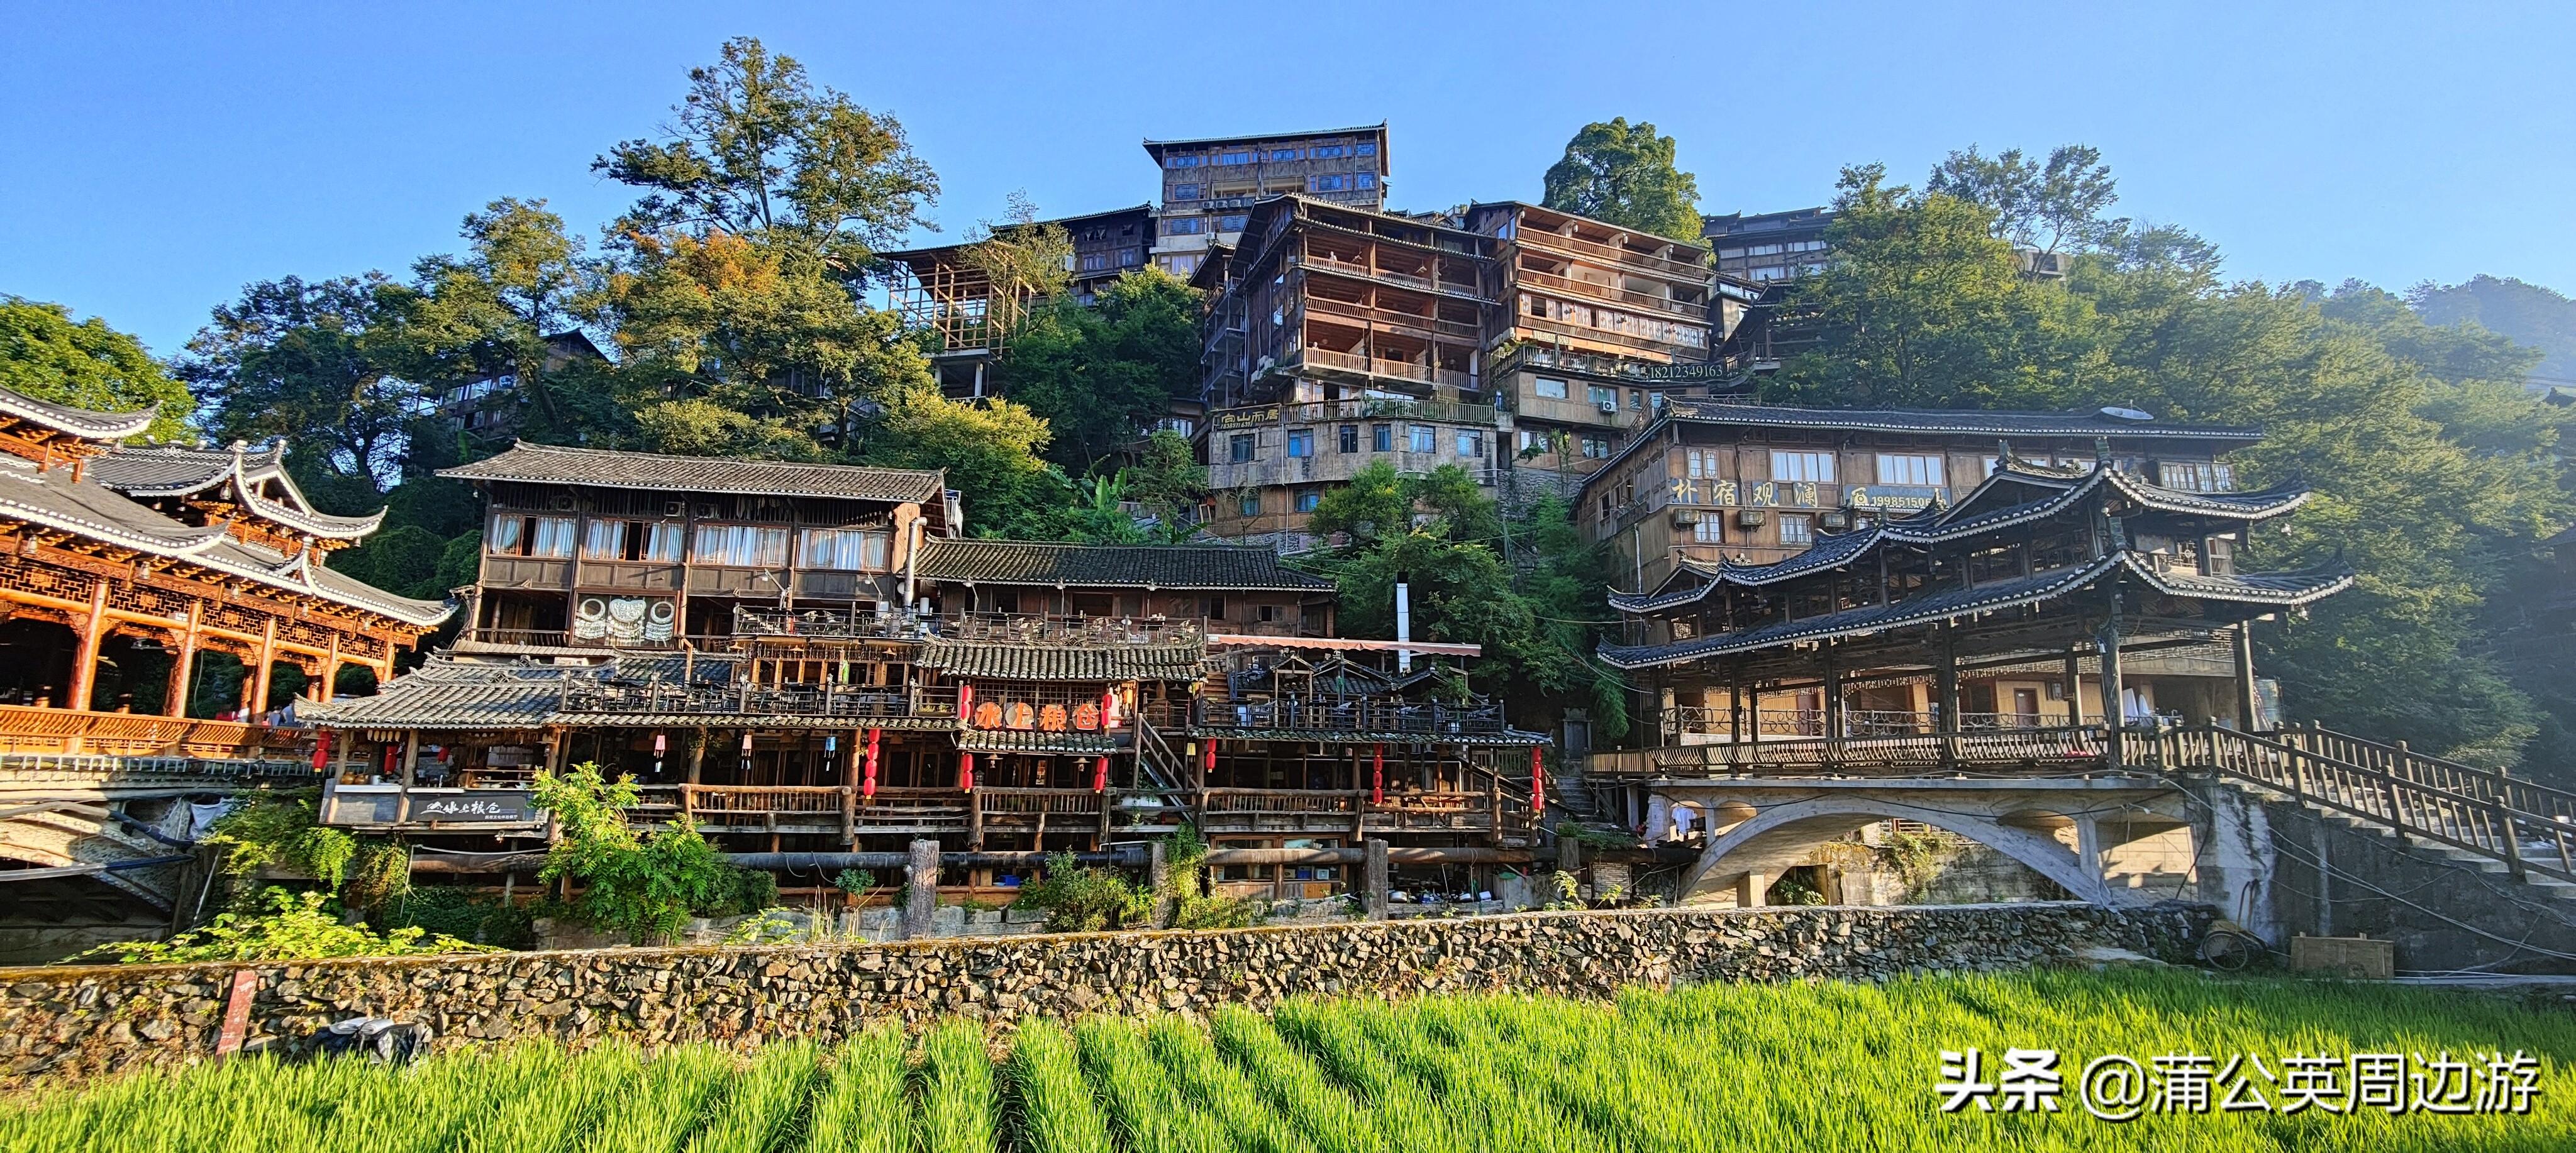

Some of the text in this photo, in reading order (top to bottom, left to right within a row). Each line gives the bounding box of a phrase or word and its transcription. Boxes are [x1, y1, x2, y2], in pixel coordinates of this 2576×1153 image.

[1650, 365, 1722, 378] 18212349163
[1221, 409, 1279, 423] 向山而居
[1672, 478, 1818, 508] 朴宿观澜
[1872, 495, 1946, 507] 199851506
[975, 702, 1099, 732] 水上粮仓
[443, 800, 501, 815] 水上粮仓
